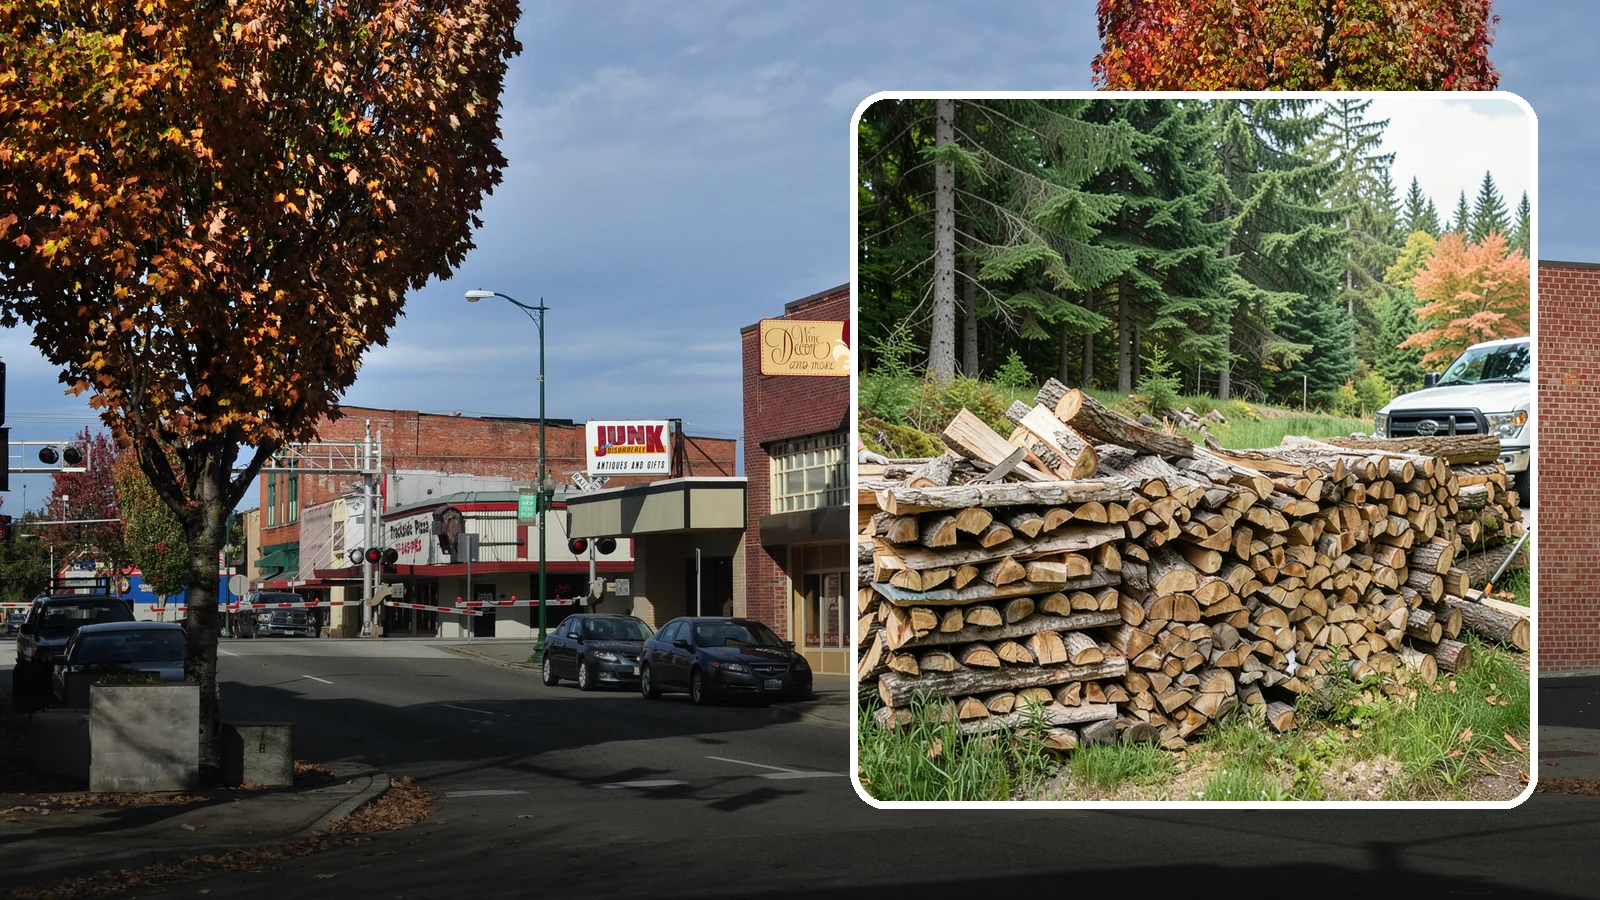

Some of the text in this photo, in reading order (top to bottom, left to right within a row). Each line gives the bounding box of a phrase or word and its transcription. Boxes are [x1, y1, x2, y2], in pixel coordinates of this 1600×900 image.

[596, 425, 665, 457] JUNK
[607, 445, 646, 454] DISORDERLY
[597, 460, 665, 470] ANTIQUES AND GIFTS
[415, 520, 429, 534] Pizza
